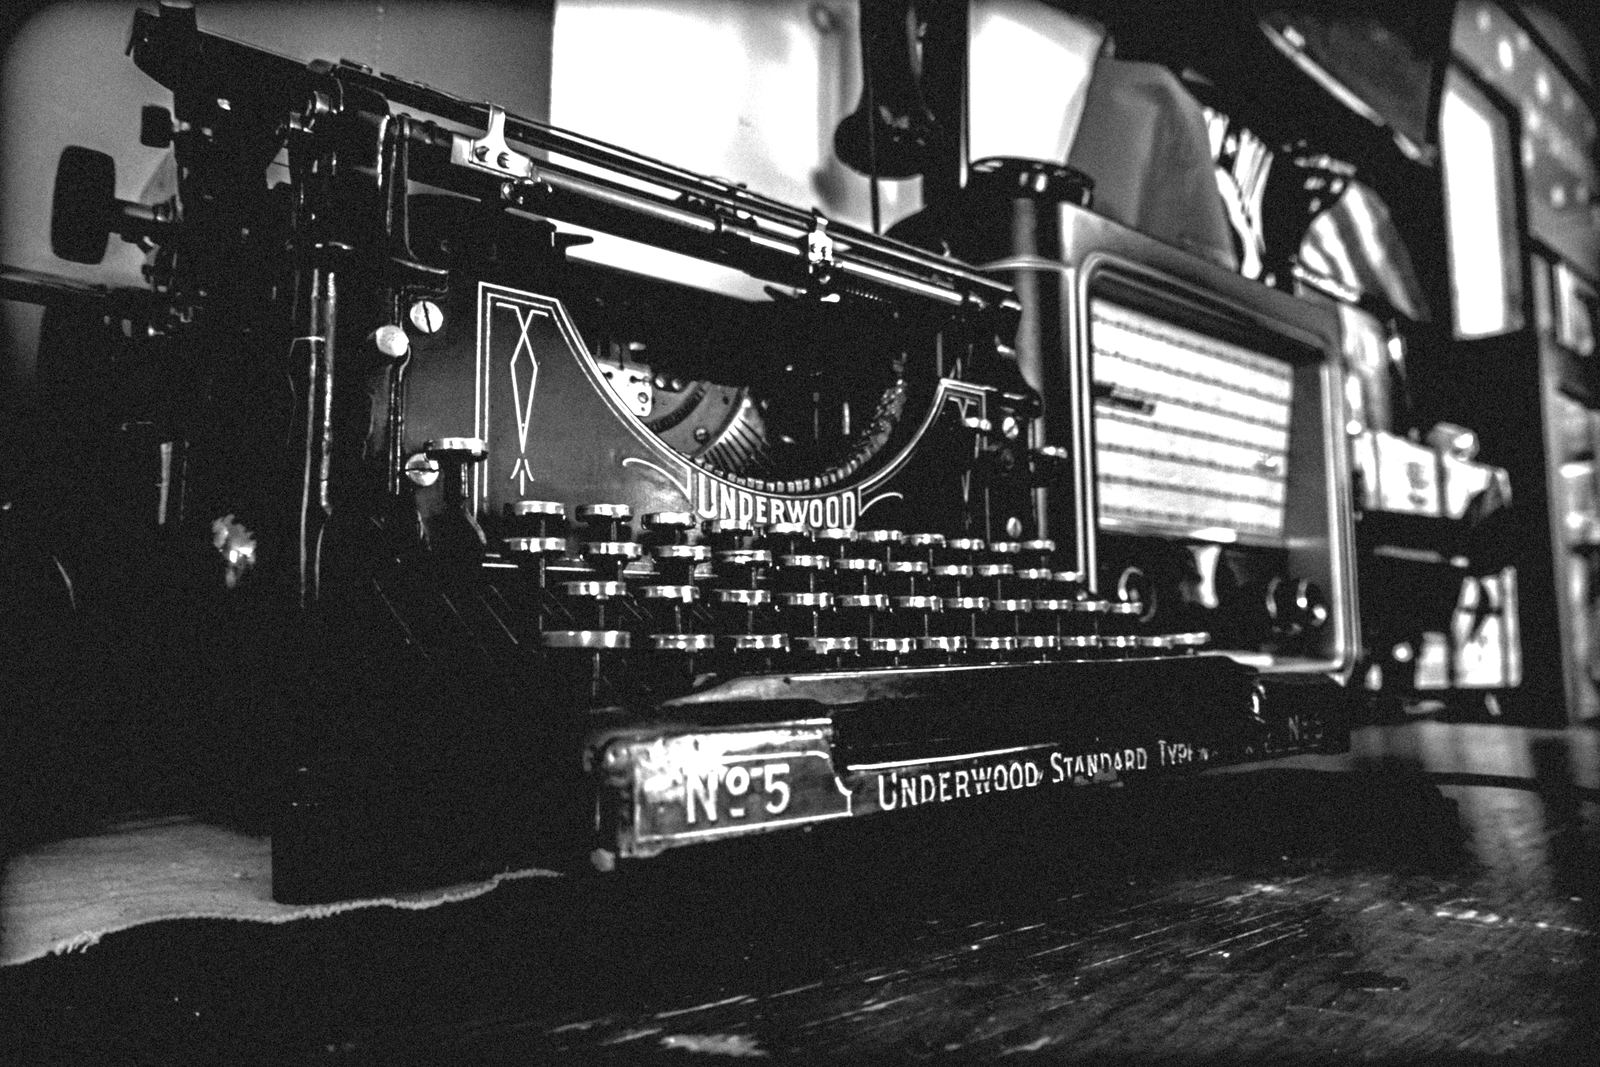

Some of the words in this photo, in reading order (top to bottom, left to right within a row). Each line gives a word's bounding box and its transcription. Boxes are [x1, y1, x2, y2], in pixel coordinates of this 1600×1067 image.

[698, 473, 856, 530] UNDERWOOD
[878, 761, 1039, 811] UNDERWOOD
[1050, 747, 1148, 783] STANDARD
